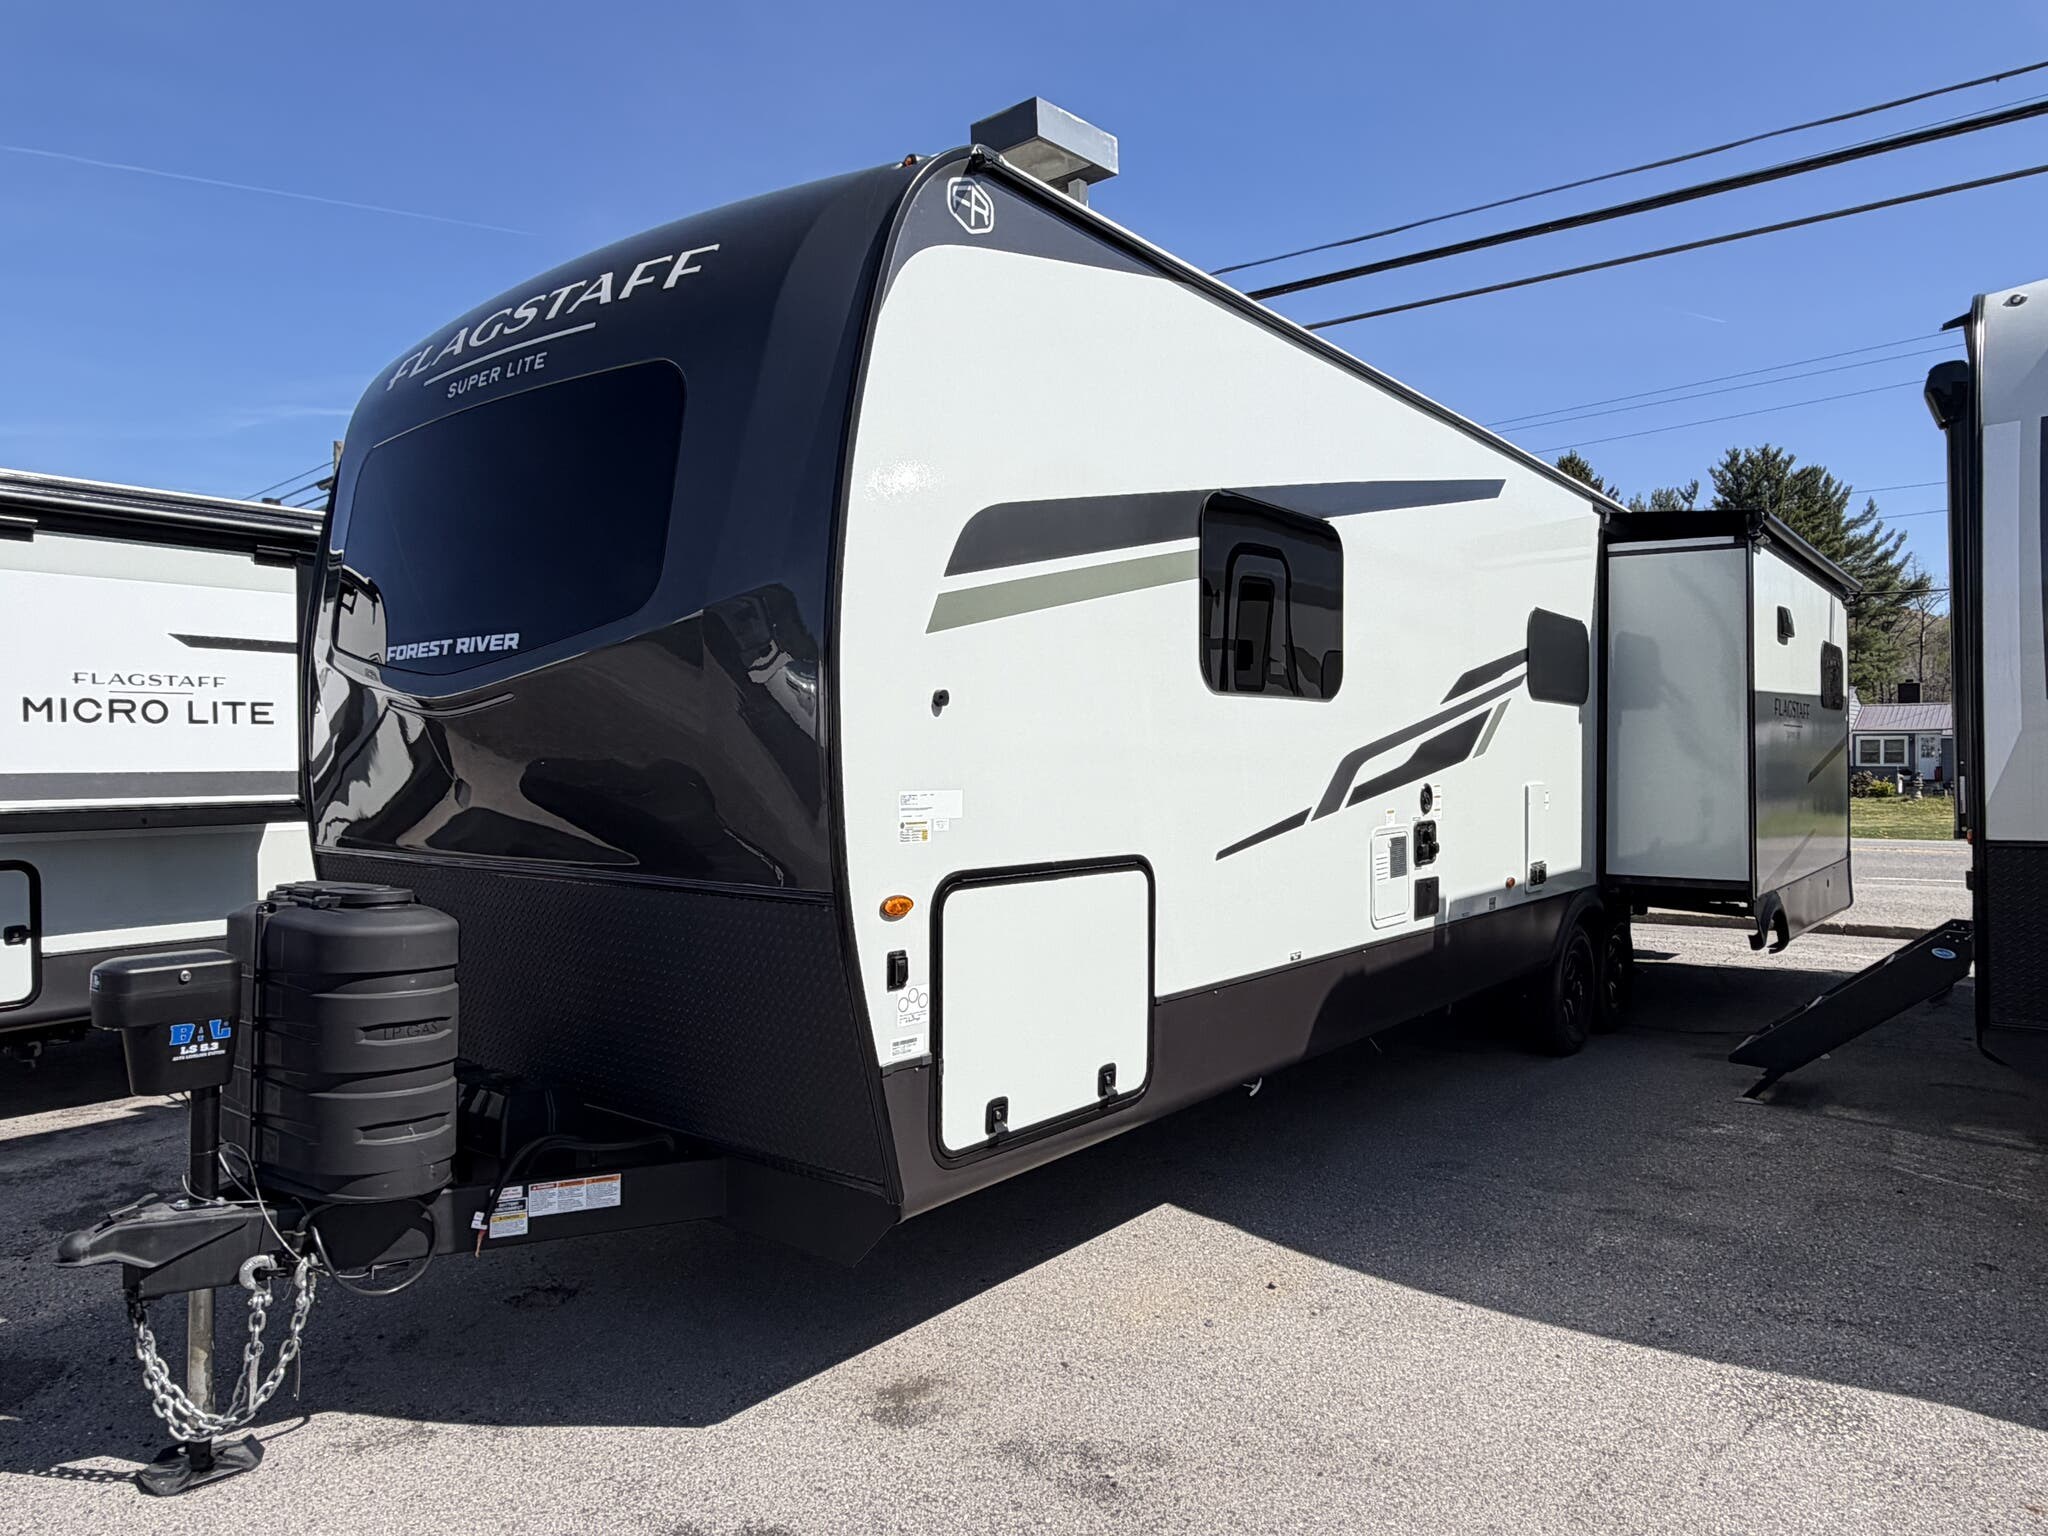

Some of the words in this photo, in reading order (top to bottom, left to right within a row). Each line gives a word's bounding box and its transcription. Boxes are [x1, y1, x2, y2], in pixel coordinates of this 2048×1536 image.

[386, 243, 720, 392] FLAGSTAFF
[447, 365, 501, 399] SUPER
[506, 352, 548, 379] LITE
[386, 639, 453, 662] FOREST
[455, 632, 520, 654] RIVER
[72, 672, 226, 688] FLAGSTAFF
[22, 696, 169, 724] MICRO
[187, 700, 275, 725] LITE
